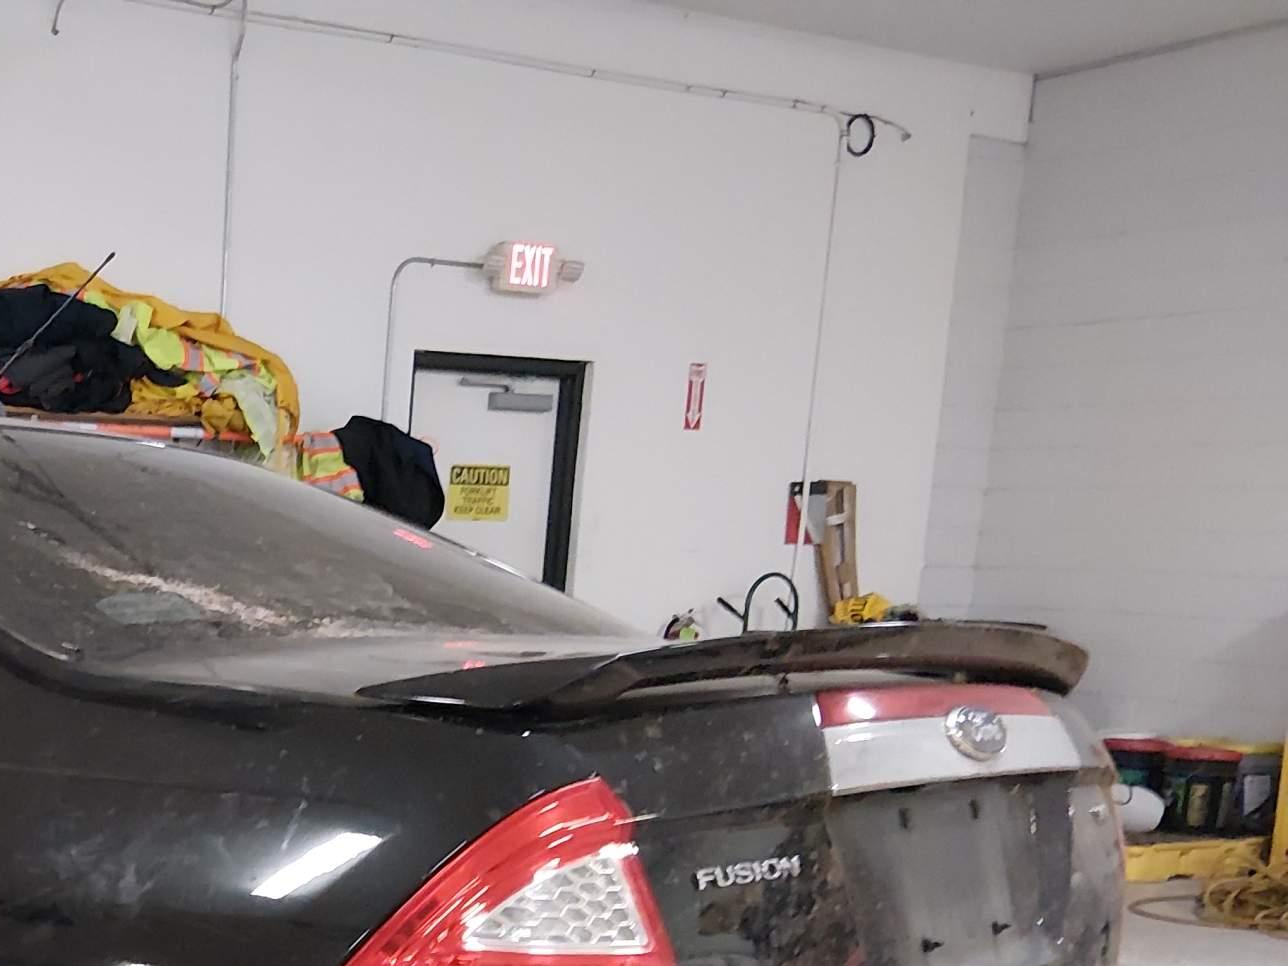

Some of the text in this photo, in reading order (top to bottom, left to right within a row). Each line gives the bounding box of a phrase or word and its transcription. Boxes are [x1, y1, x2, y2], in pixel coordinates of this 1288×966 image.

[509, 244, 554, 288] EXIT
[452, 468, 508, 485] CAUTION
[696, 854, 801, 891] FUSION
